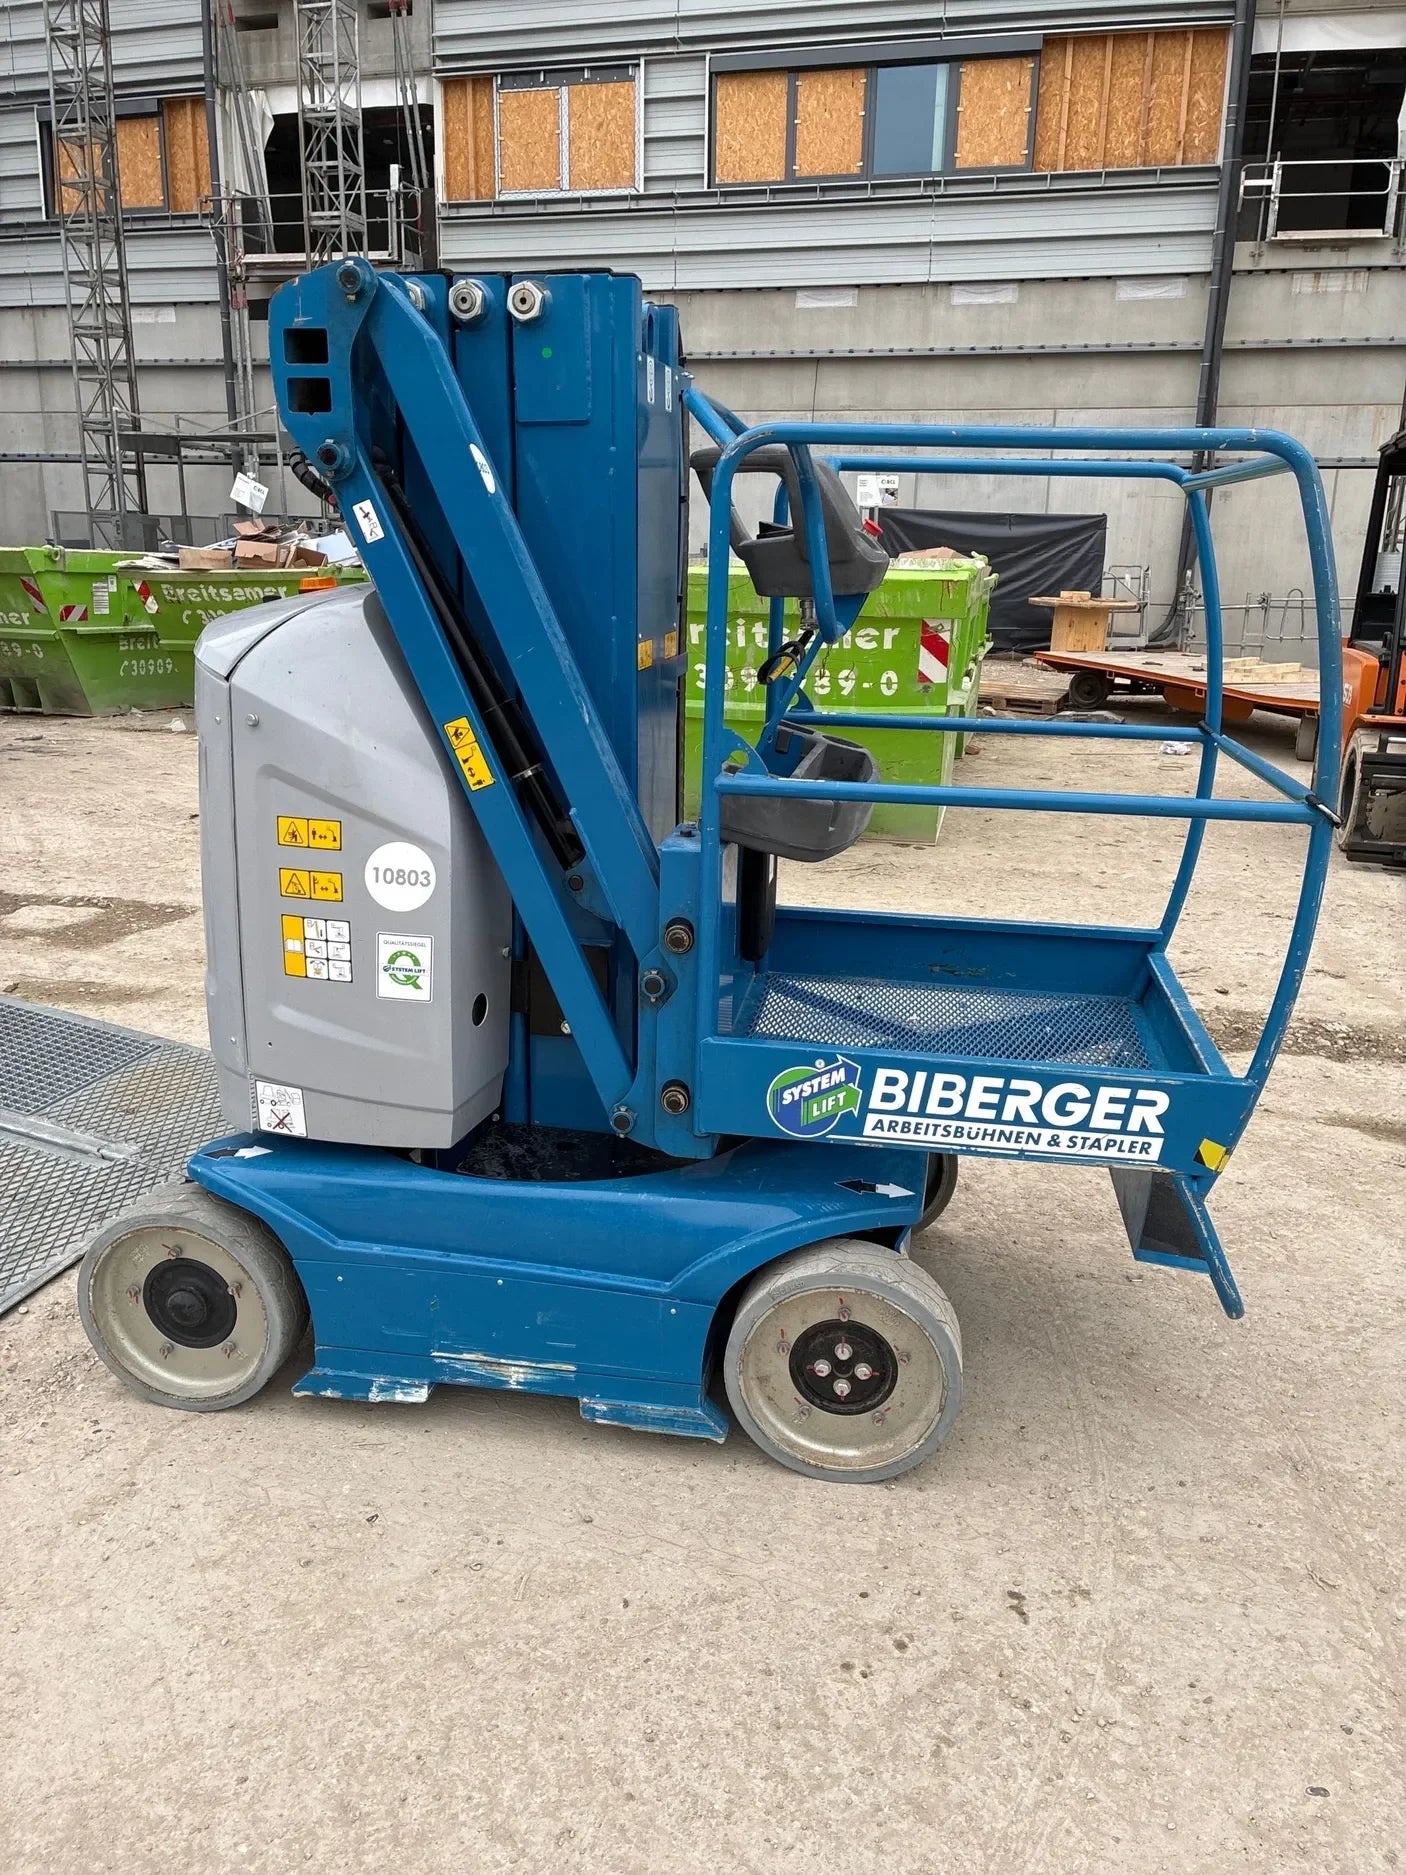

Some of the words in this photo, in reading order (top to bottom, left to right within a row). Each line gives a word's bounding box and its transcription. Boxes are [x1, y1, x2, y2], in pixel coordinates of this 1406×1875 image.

[160, 583, 287, 602] Breitsamer
[372, 866, 432, 888] 10803
[383, 939, 427, 948] QUALITÄTSSIEGEL
[782, 1067, 846, 1105] SYSTEM
[812, 1091, 847, 1118] LIFT
[868, 1067, 1170, 1134] BIBERGER
[871, 1118, 1042, 1146] ARBEITSBÜHNEN
[1046, 1133, 1062, 1148] &
[1066, 1135, 1153, 1155] STAPLER
